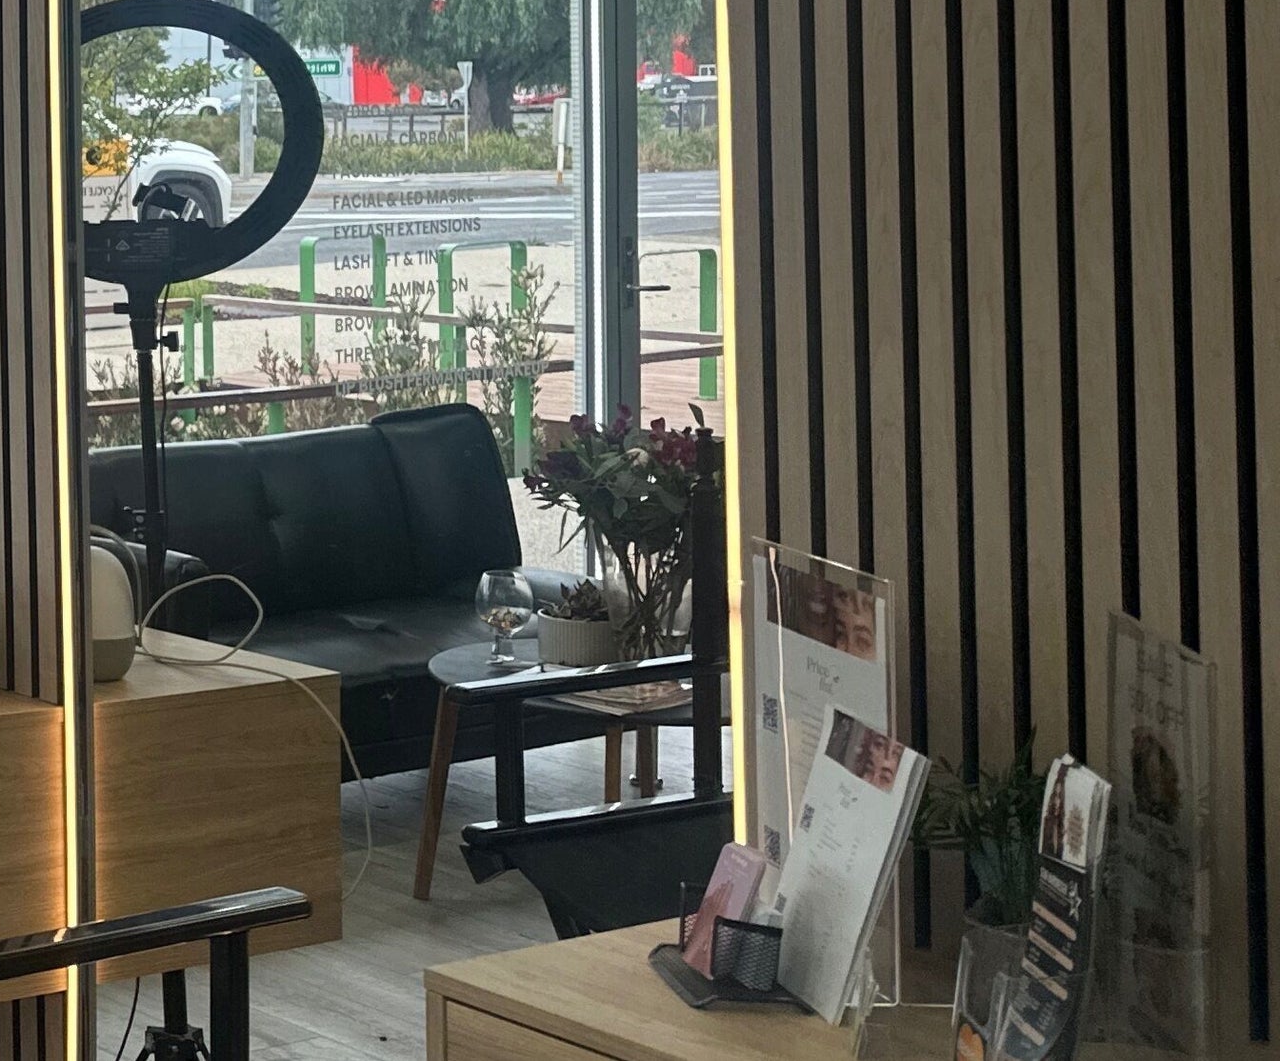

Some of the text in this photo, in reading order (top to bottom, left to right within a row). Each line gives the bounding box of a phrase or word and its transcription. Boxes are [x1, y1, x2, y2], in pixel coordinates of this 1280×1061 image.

[332, 133, 381, 148] FACIAL
[398, 130, 457, 147] CARBON
[332, 194, 383, 211] FACIAL
[386, 192, 397, 208] &
[400, 191, 423, 207] LED
[333, 217, 482, 239] EYELASH EXTENSIONS
[334, 253, 370, 272] LASH
[403, 251, 414, 267] &
[416, 249, 447, 266] TINT
[380, 275, 469, 297] AMINATION
[335, 362, 549, 396] LIP BLUSH PERMANENT MAKEUP
